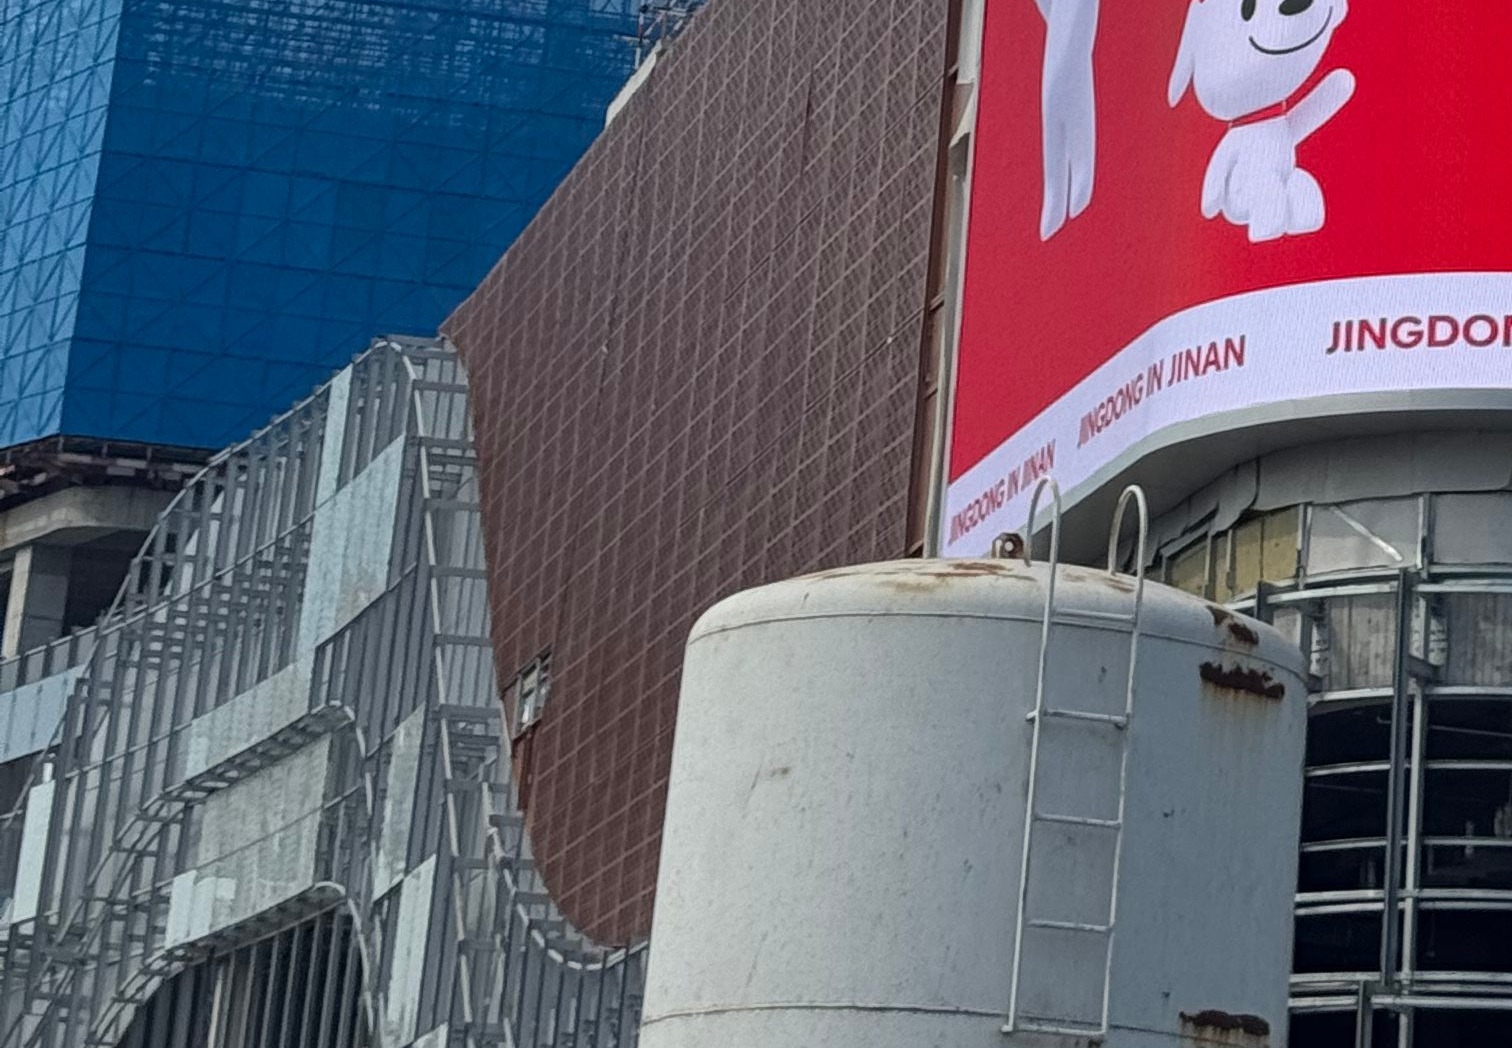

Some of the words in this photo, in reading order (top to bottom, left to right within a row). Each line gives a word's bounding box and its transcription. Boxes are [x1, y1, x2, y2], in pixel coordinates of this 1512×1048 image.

[1077, 373, 1144, 449] JINGDONG
[1146, 358, 1164, 397] IN
[1168, 334, 1246, 387] JINAN
